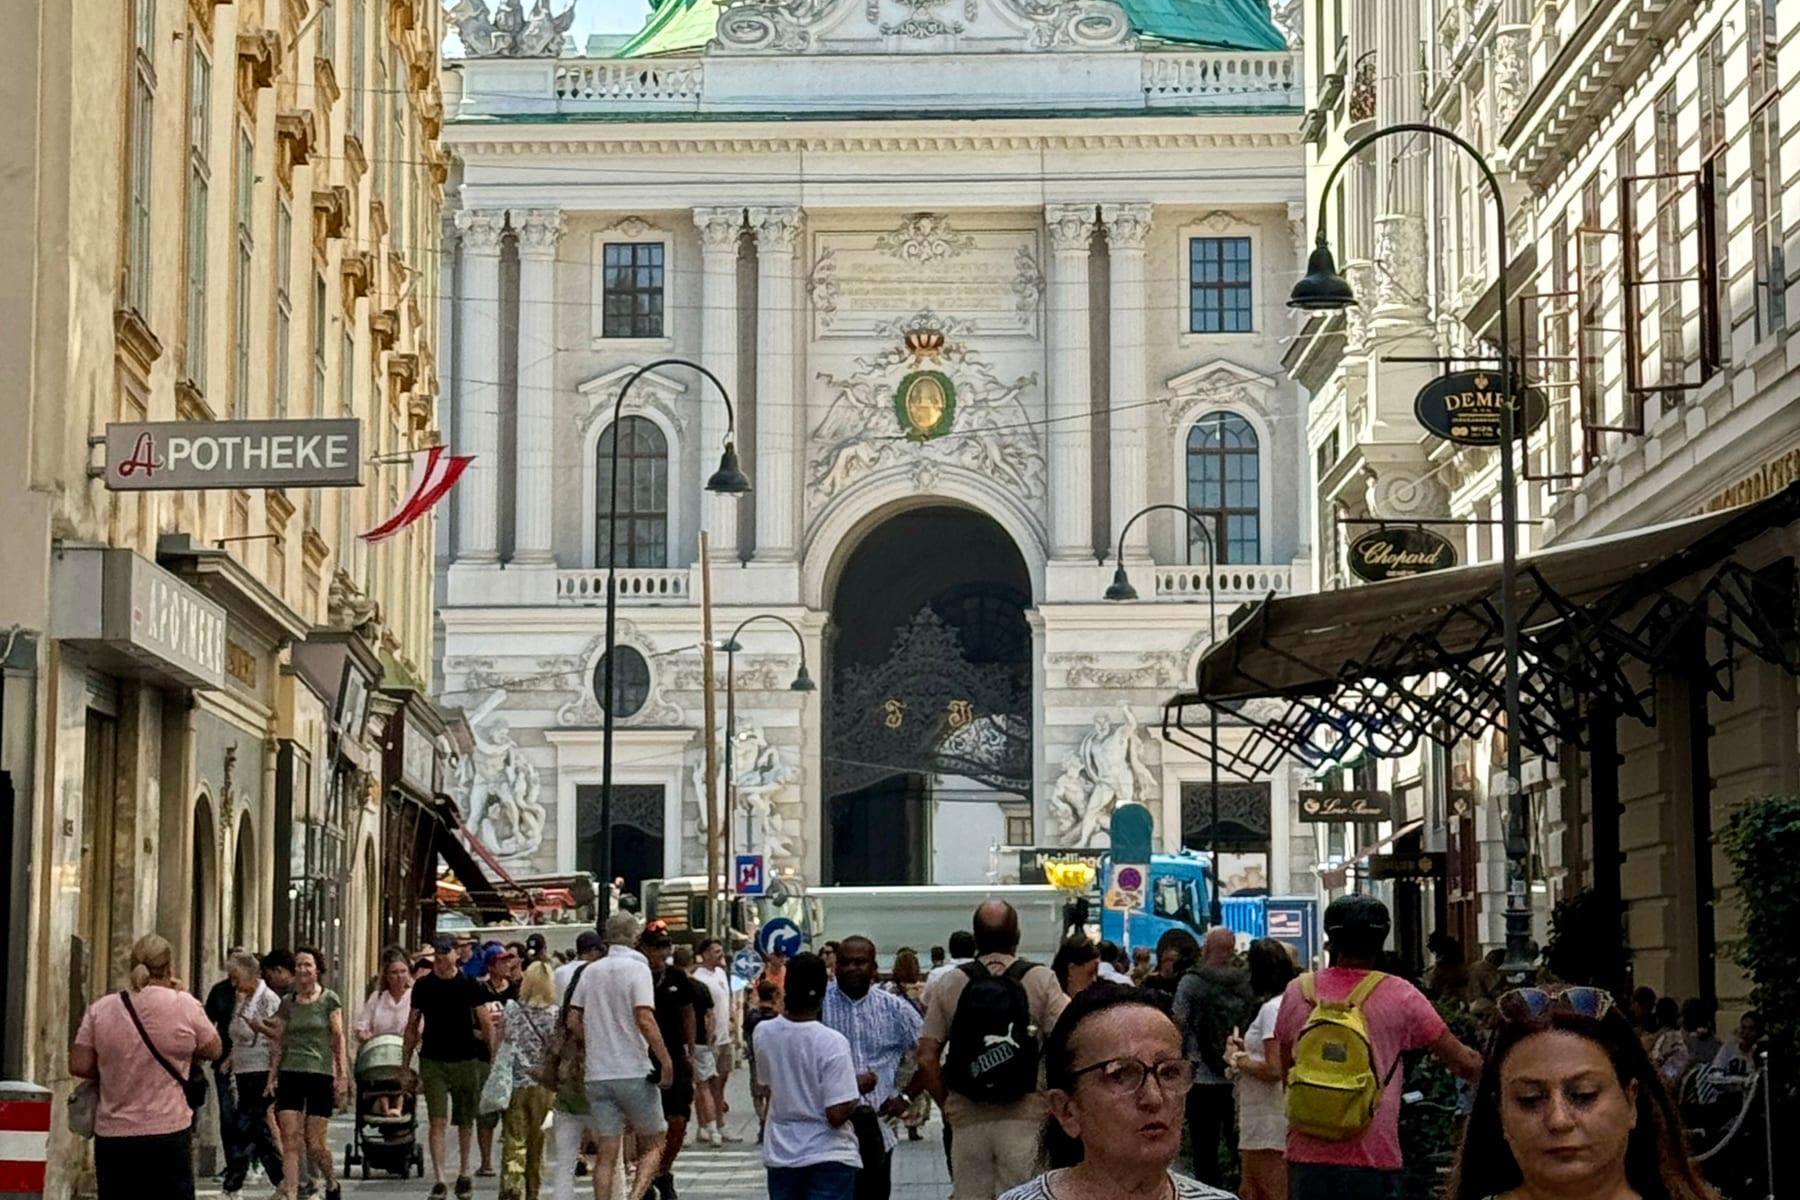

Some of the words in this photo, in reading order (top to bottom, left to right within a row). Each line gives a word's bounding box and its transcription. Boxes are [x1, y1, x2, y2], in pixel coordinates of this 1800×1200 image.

[118, 430, 349, 478] APOTHEKE
[1358, 539, 1445, 569] Chopard
[147, 578, 222, 675] APOTHEKE
